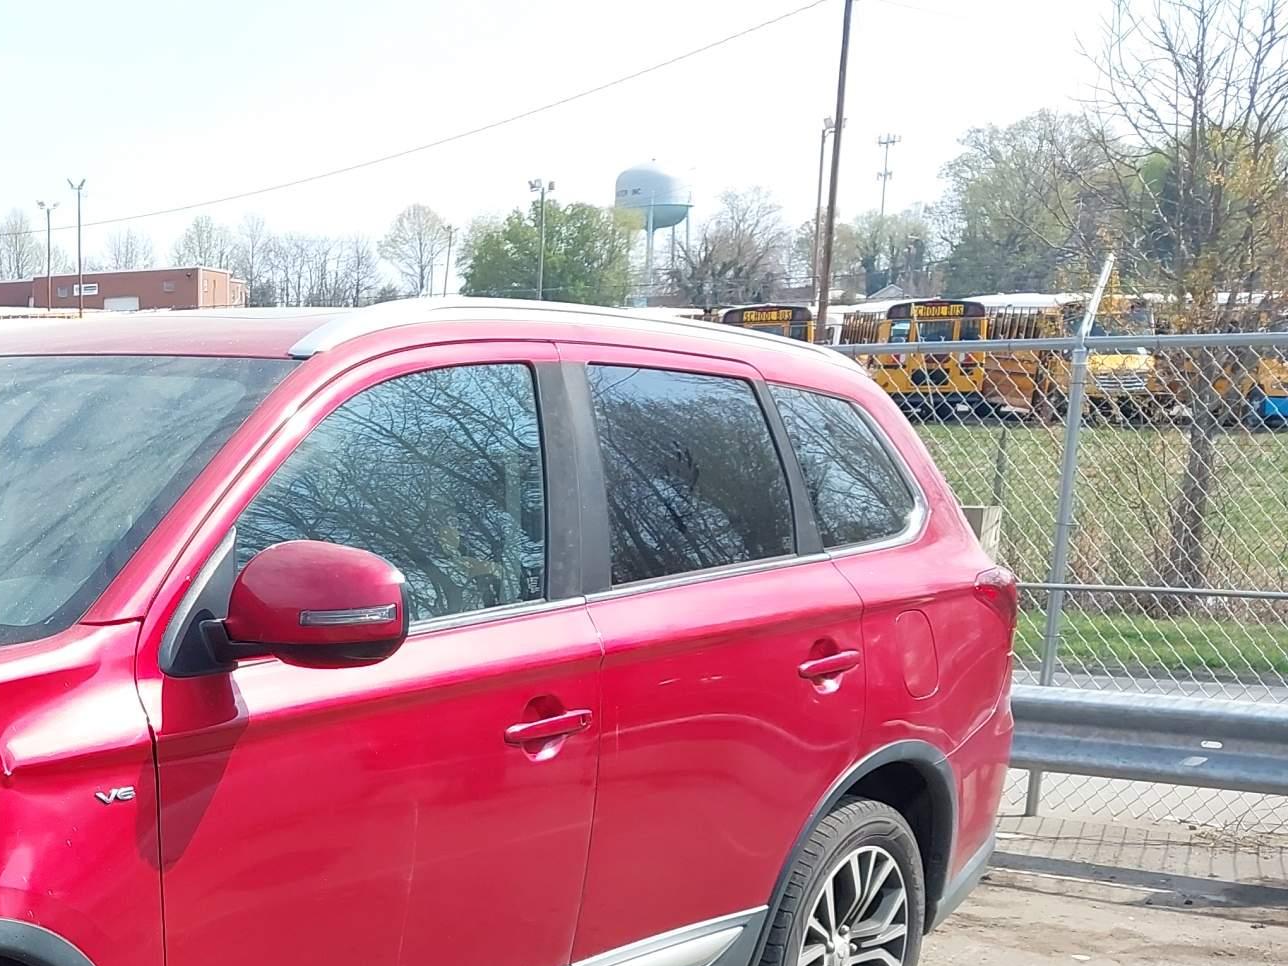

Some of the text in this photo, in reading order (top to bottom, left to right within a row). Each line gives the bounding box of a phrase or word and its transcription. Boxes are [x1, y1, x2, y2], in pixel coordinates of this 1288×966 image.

[743, 310, 792, 321] SCHOOL BUS
[946, 304, 964, 316] BUS
[95, 786, 136, 804] V6
